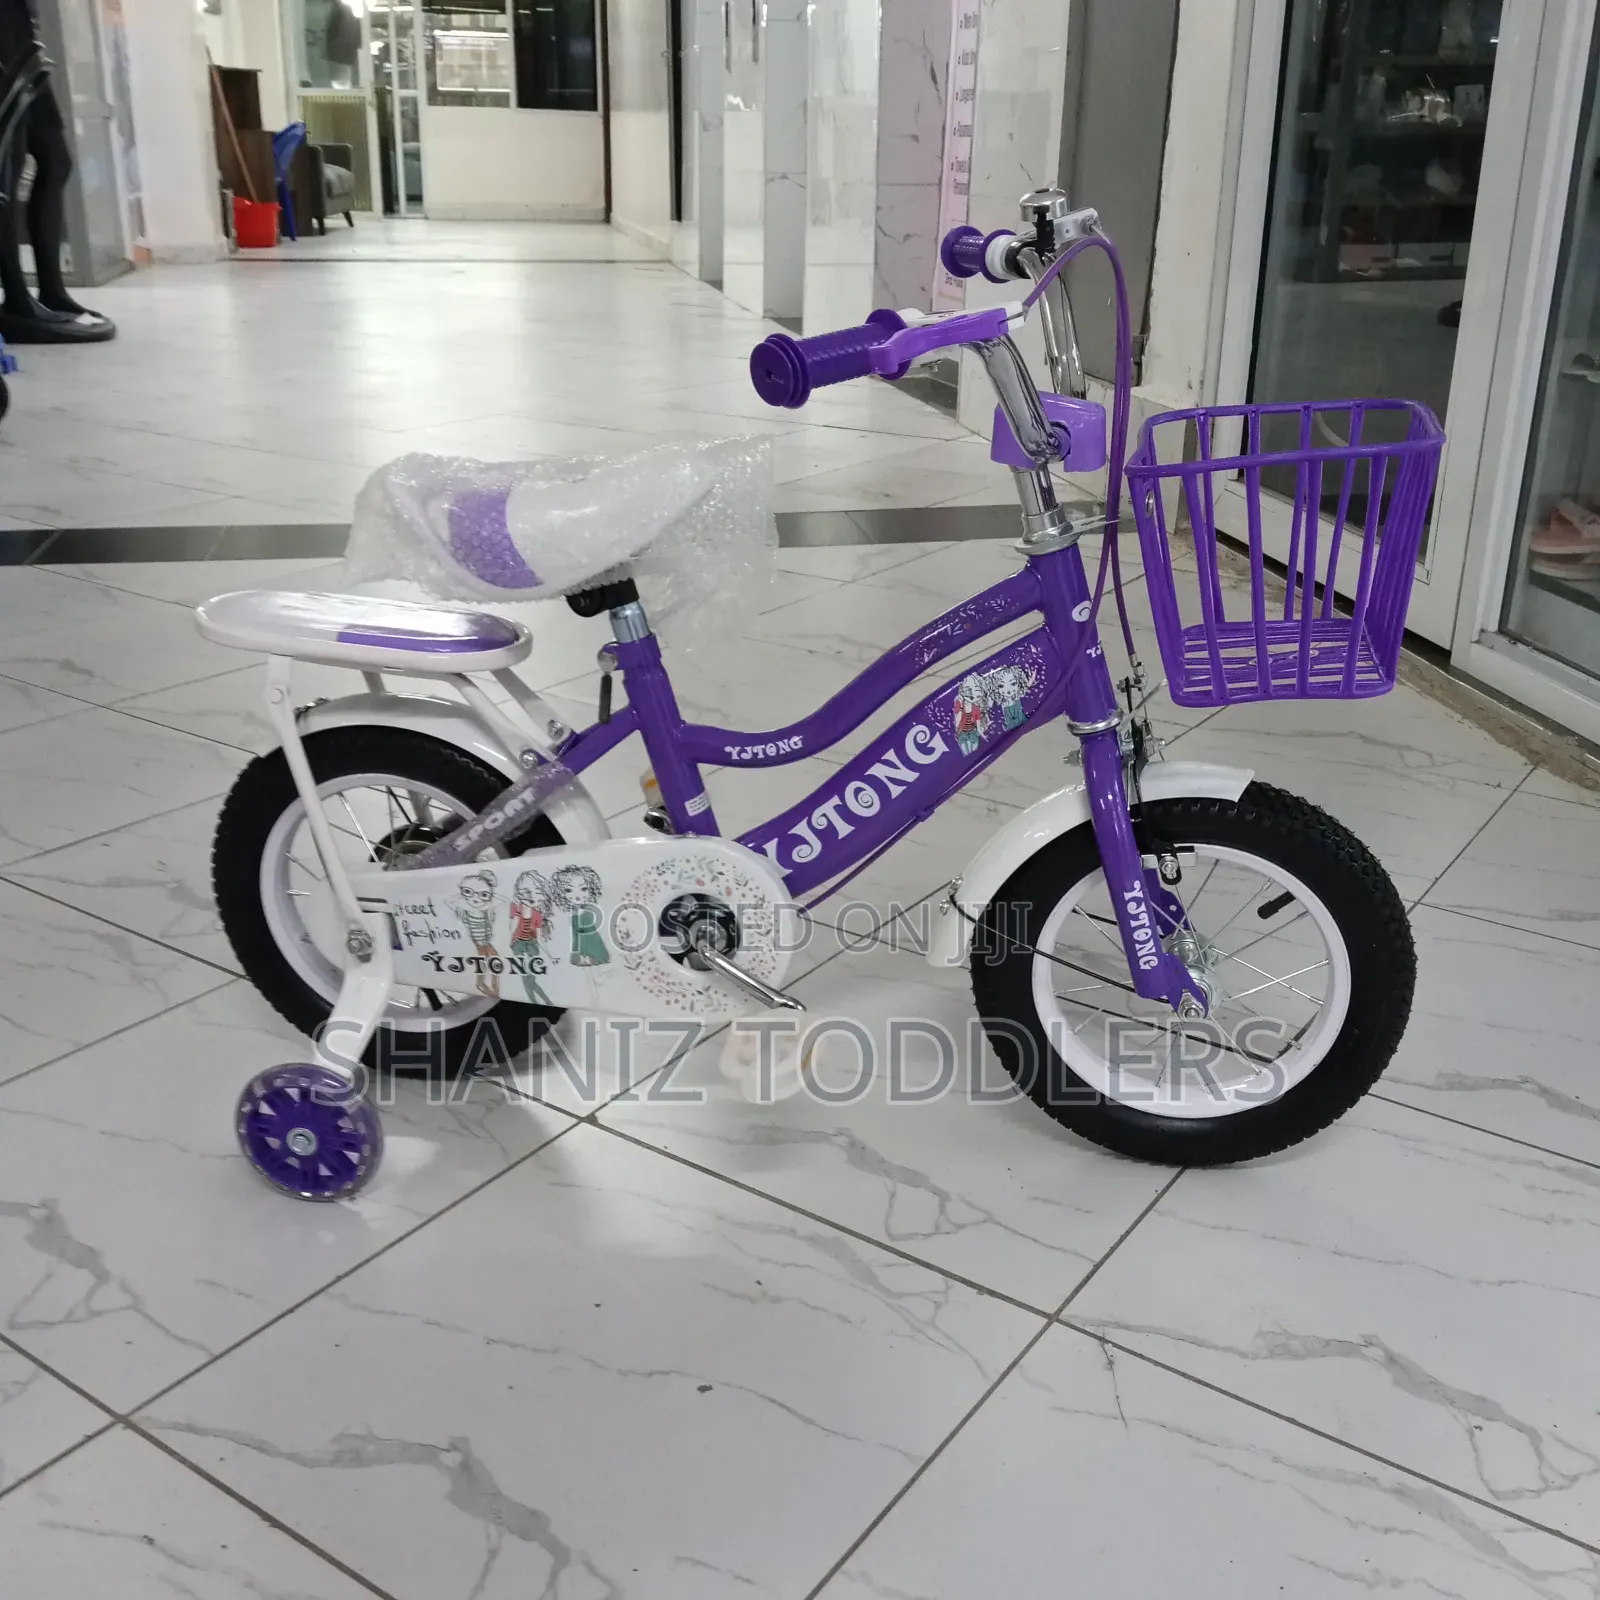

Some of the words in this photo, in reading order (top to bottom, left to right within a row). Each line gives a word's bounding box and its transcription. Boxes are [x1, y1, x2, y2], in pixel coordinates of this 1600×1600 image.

[723, 735, 804, 760] YJTONG
[1123, 879, 1159, 970] YJTONG
[421, 950, 548, 976] YJTONG
